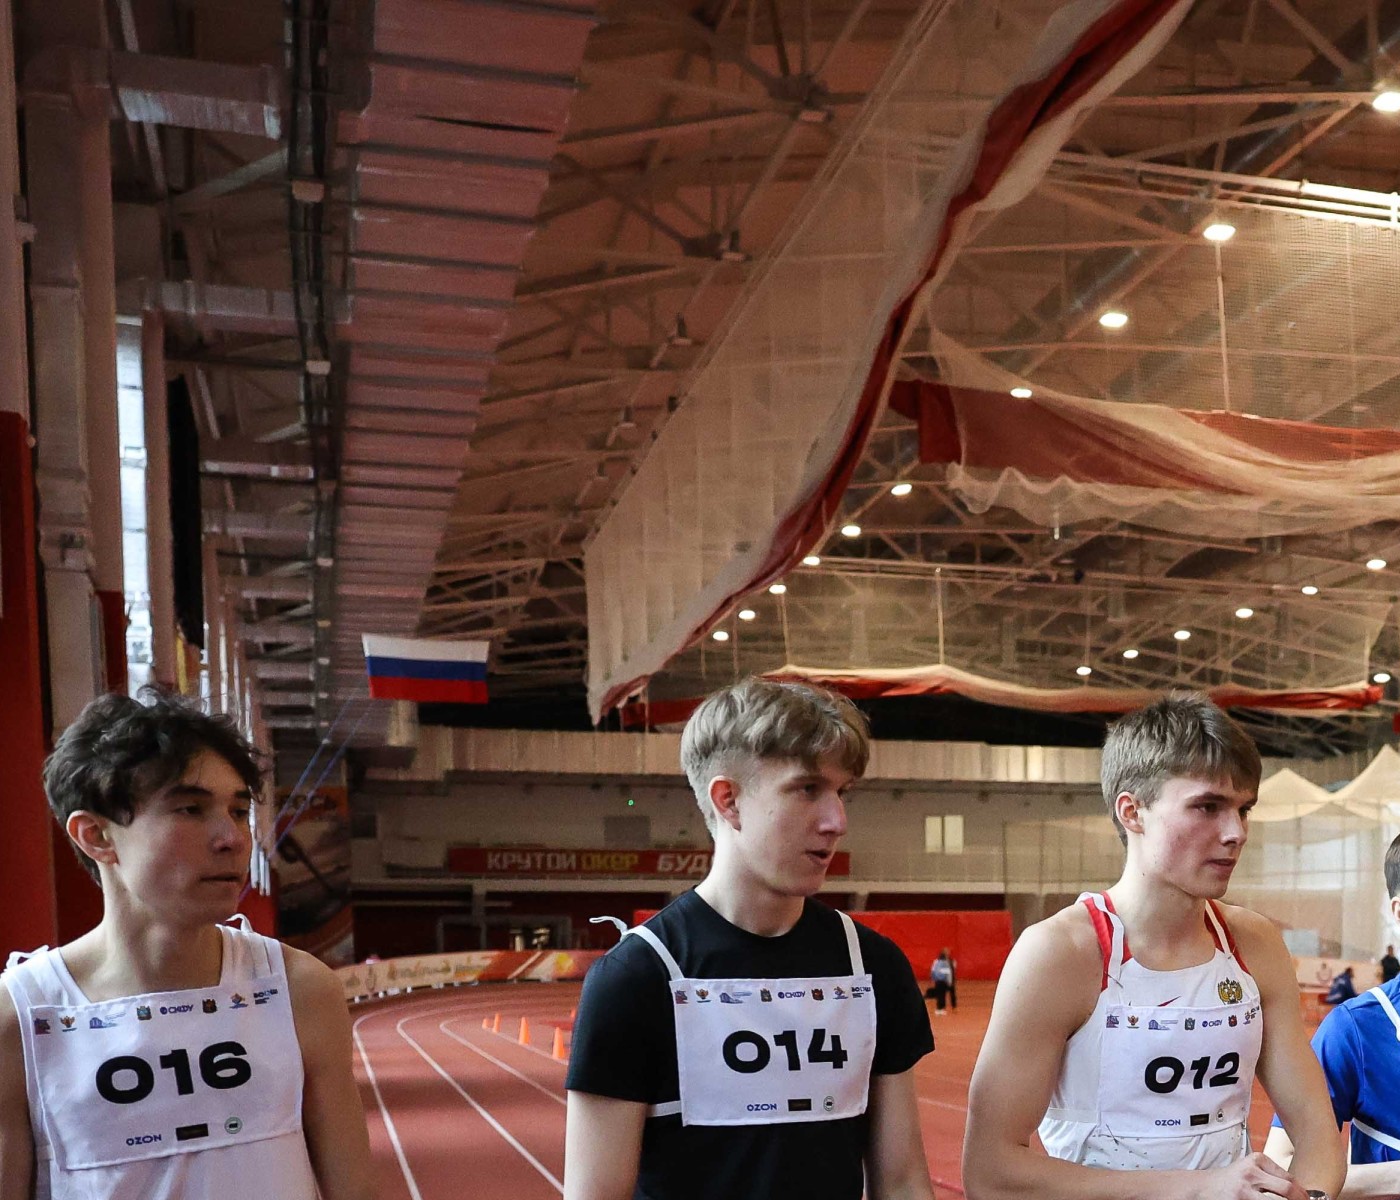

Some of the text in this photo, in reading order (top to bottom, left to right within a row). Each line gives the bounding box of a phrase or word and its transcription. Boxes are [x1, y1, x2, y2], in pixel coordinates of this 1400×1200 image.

[656, 852, 713, 873] БУД
[722, 1028, 848, 1074] 014
[95, 1041, 252, 1104] 016
[1144, 1052, 1240, 1094] 012
[746, 1102, 778, 1112] OZON
[1154, 1118, 1181, 1127] OZON
[125, 1133, 163, 1146] OZON
